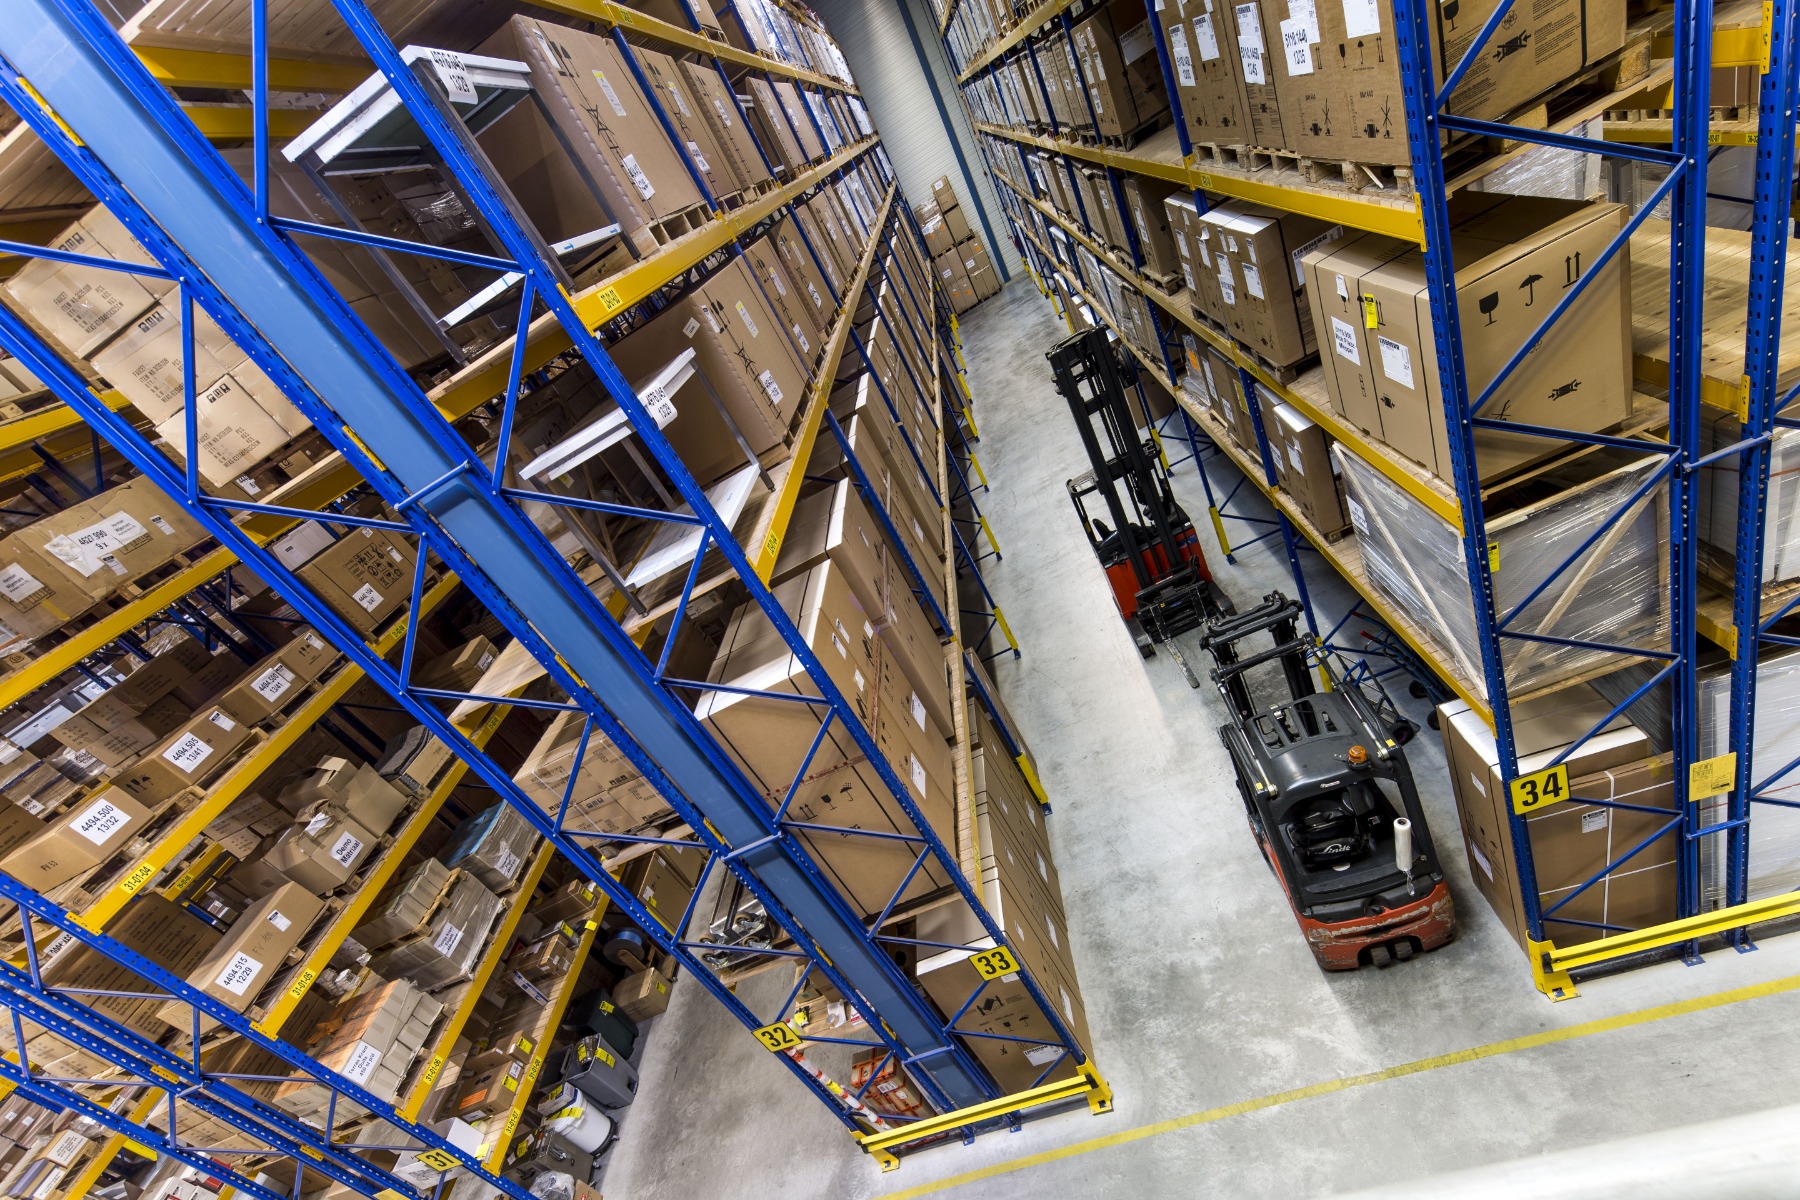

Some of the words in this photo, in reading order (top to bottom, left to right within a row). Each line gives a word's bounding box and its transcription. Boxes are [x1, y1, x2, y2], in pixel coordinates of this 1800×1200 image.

[53, 292, 68, 305] FAUCET
[61, 302, 72, 312] ITEM
[132, 364, 146, 377] FAUCET
[259, 672, 279, 692] 4494.500
[270, 682, 283, 694] 13/41
[172, 737, 199, 761] 4494.505
[186, 747, 204, 762] 13/41
[1520, 772, 1562, 806] 34
[81, 804, 114, 832] 4494.500
[97, 815, 119, 834] 13/32
[336, 839, 351, 855] Demo
[1320, 844, 1350, 854] Linde
[124, 866, 152, 891] 31-01-04
[224, 957, 248, 986] 4494.515
[977, 951, 1011, 975] 33
[236, 966, 252, 984] 12/29
[292, 972, 313, 996] 31-01-05
[760, 1026, 795, 1049] 32
[348, 1058, 359, 1074] Terras
[358, 1045, 367, 1058] Krant
[426, 1058, 442, 1082] 31-01-06
[505, 1111, 519, 1134] 31-01-07
[426, 1152, 455, 1167] 31
